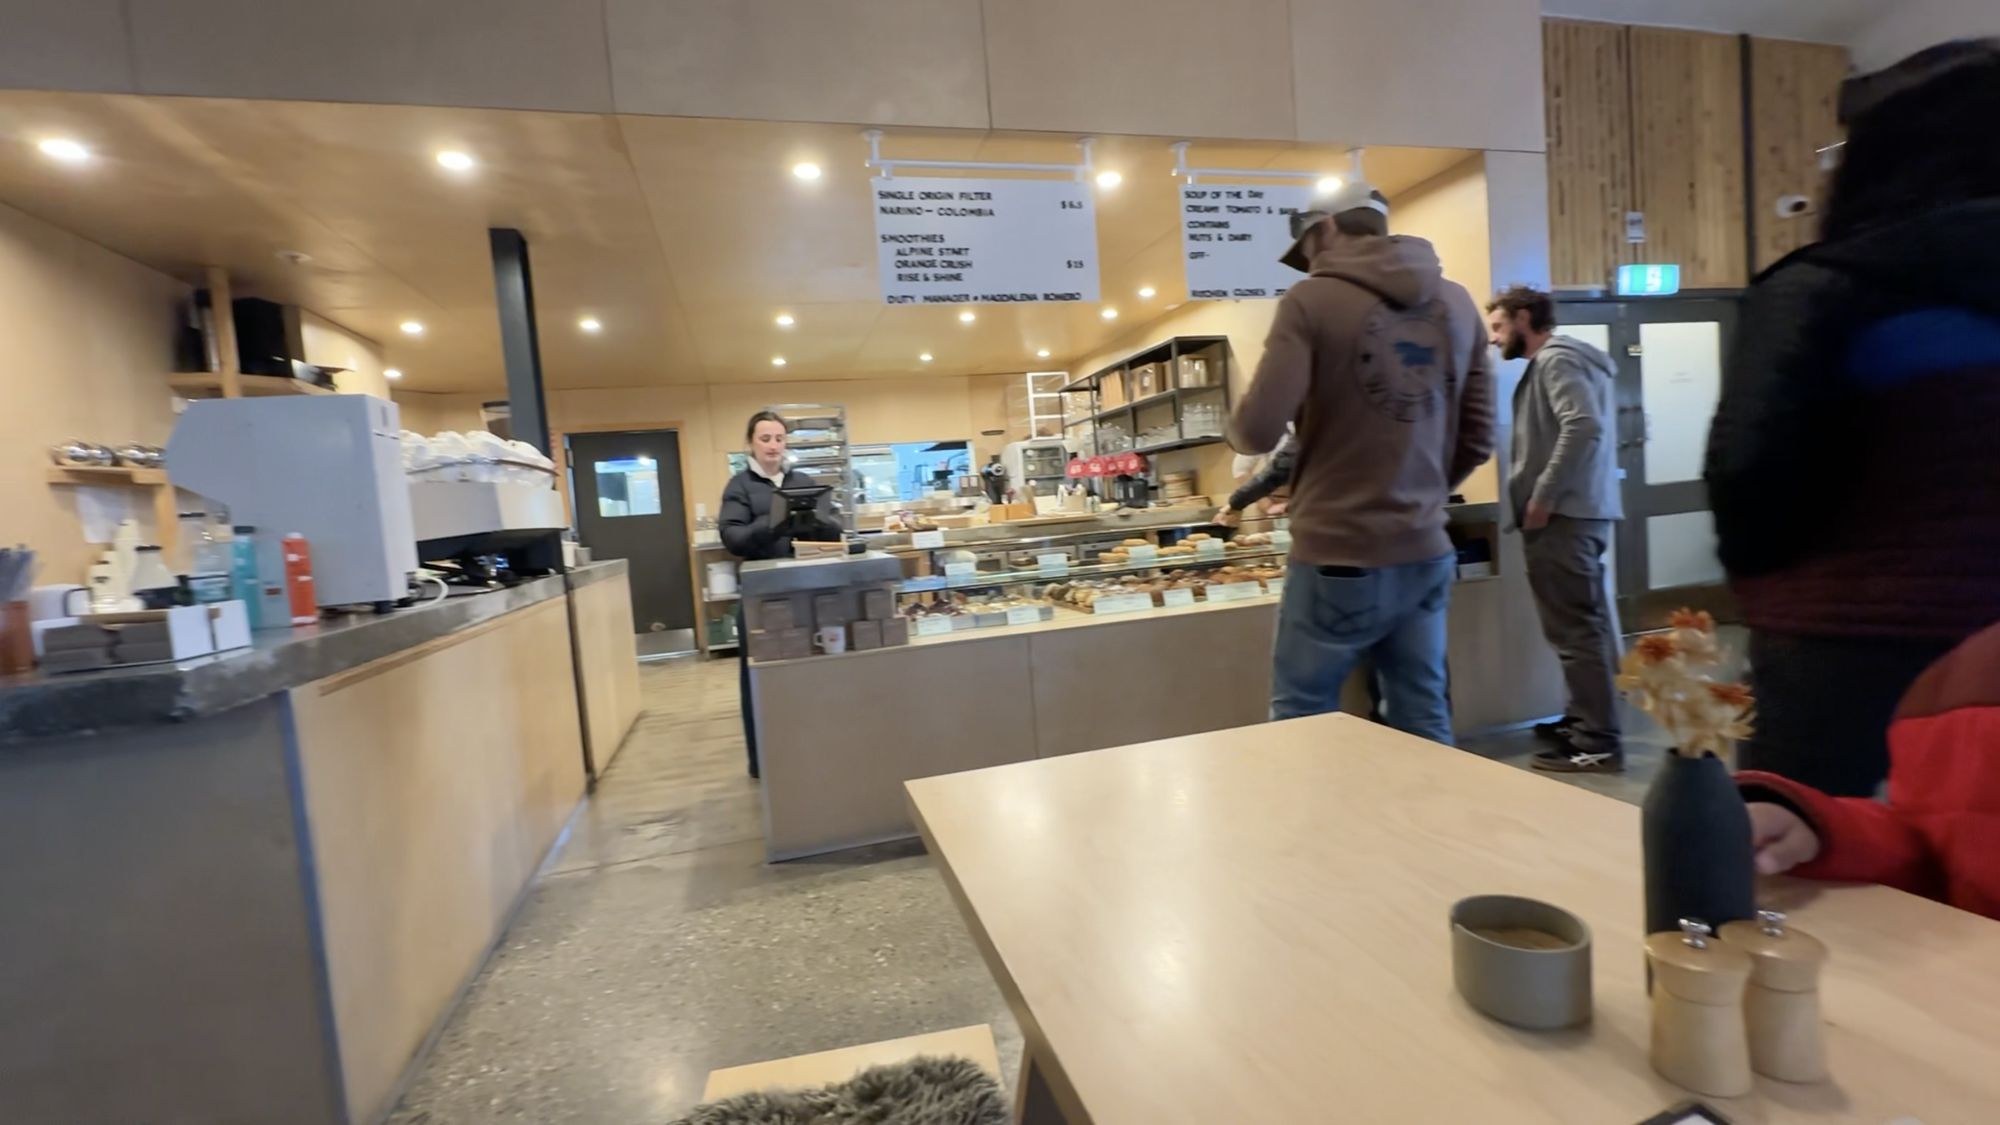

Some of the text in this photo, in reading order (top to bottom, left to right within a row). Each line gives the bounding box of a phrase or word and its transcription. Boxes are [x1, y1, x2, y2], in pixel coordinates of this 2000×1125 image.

[878, 191, 992, 200] SINGLE ORIGIN FILTER
[1184, 190, 1264, 199] SOUP OF THE DAY
[937, 207, 995, 216] COLOMBIA
[1186, 204, 1219, 213] CREAMY
[1225, 205, 1261, 214] TOMATO
[1187, 221, 1230, 229] CONTAINS
[881, 234, 945, 243] SMOOTHIES
[1228, 233, 1252, 241] DAIRY
[896, 247, 970, 256] ALPINE START
[895, 259, 973, 269] ORANGE CRUSH
[897, 272, 963, 282] RISE & SHINE
[887, 295, 915, 304] DUTY
[922, 293, 970, 303] MANAGER
